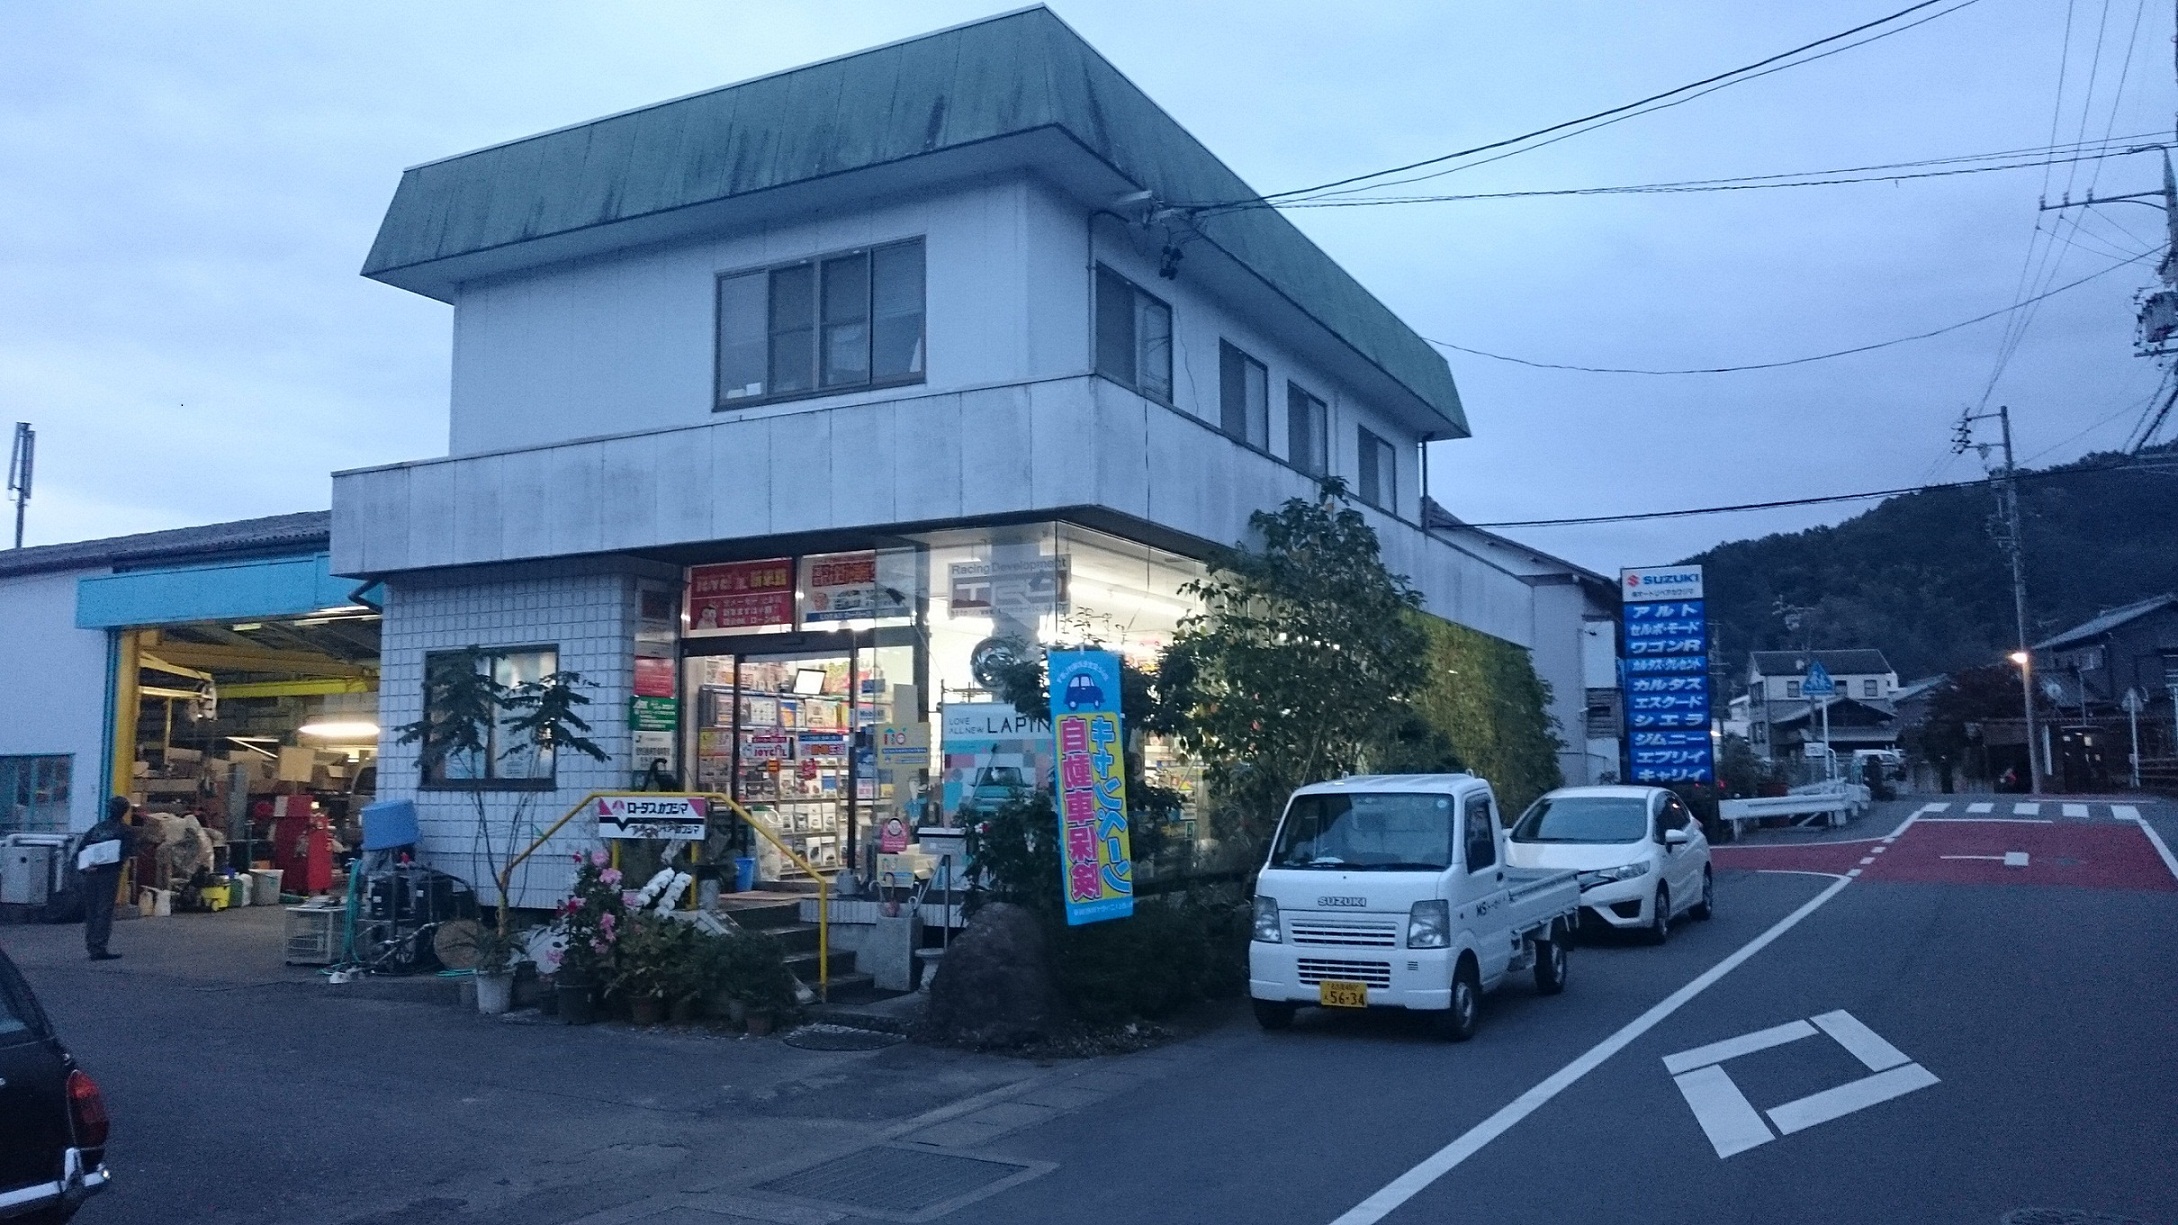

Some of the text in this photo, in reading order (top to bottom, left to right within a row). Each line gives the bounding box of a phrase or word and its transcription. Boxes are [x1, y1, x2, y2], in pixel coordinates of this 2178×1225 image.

[952, 558, 1066, 575] Racing Development
[1643, 573, 1699, 585] SUZUKI
[1633, 603, 1698, 618] アルト
[1630, 639, 1701, 654] ワゴンR
[1633, 678, 1702, 692] カルタス
[1634, 695, 1703, 709] エスクード
[948, 717, 970, 726] LOVE
[986, 717, 1051, 733] LAPIN
[1634, 713, 1704, 727] シエラ
[965, 726, 984, 734] NEW
[1635, 733, 1705, 747] ジムニー
[1637, 768, 1706, 783] キャリイ
[627, 802, 689, 815] ロータスカワシマ
[1318, 896, 1367, 907] SUZUKI
